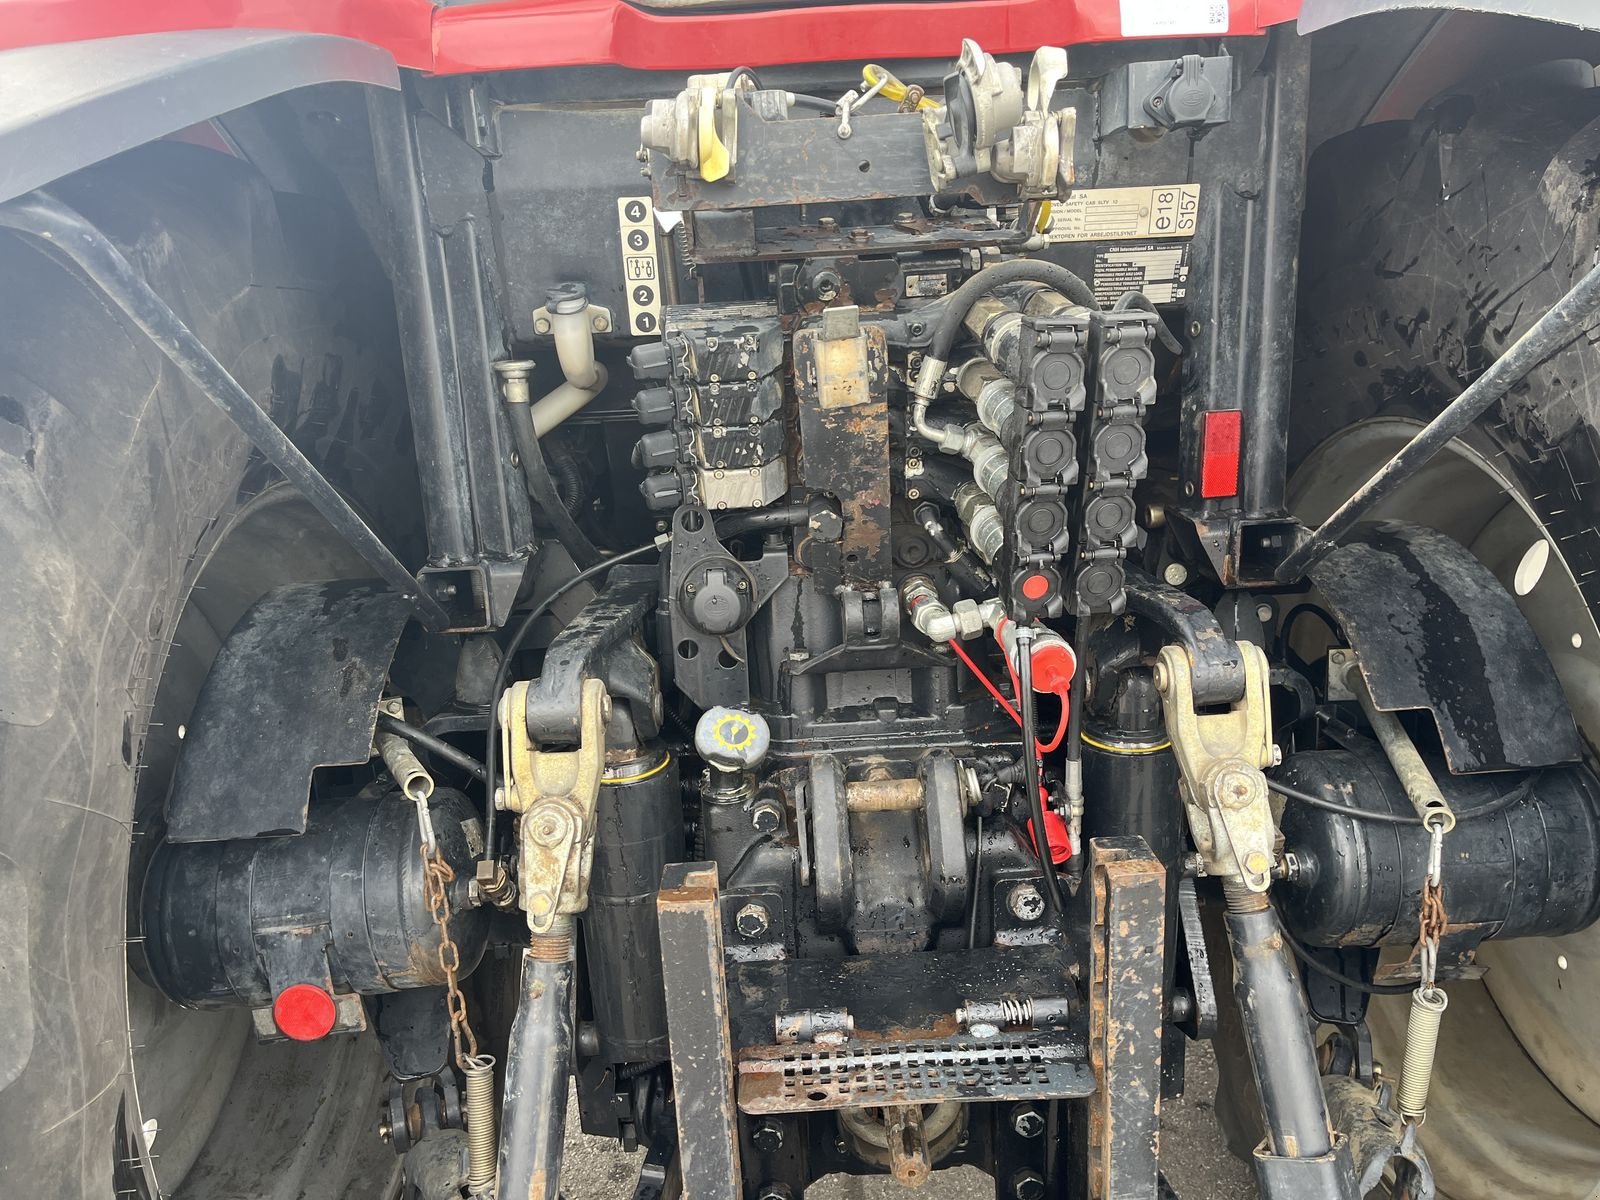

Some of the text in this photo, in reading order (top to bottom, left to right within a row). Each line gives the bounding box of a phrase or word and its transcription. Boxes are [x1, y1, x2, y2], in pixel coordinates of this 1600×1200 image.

[630, 205, 641, 218] 4
[1155, 192, 1174, 230] e18
[1178, 191, 1197, 230] S157
[633, 234, 643, 246] 3
[639, 290, 649, 302] 2
[642, 316, 650, 328] 1
